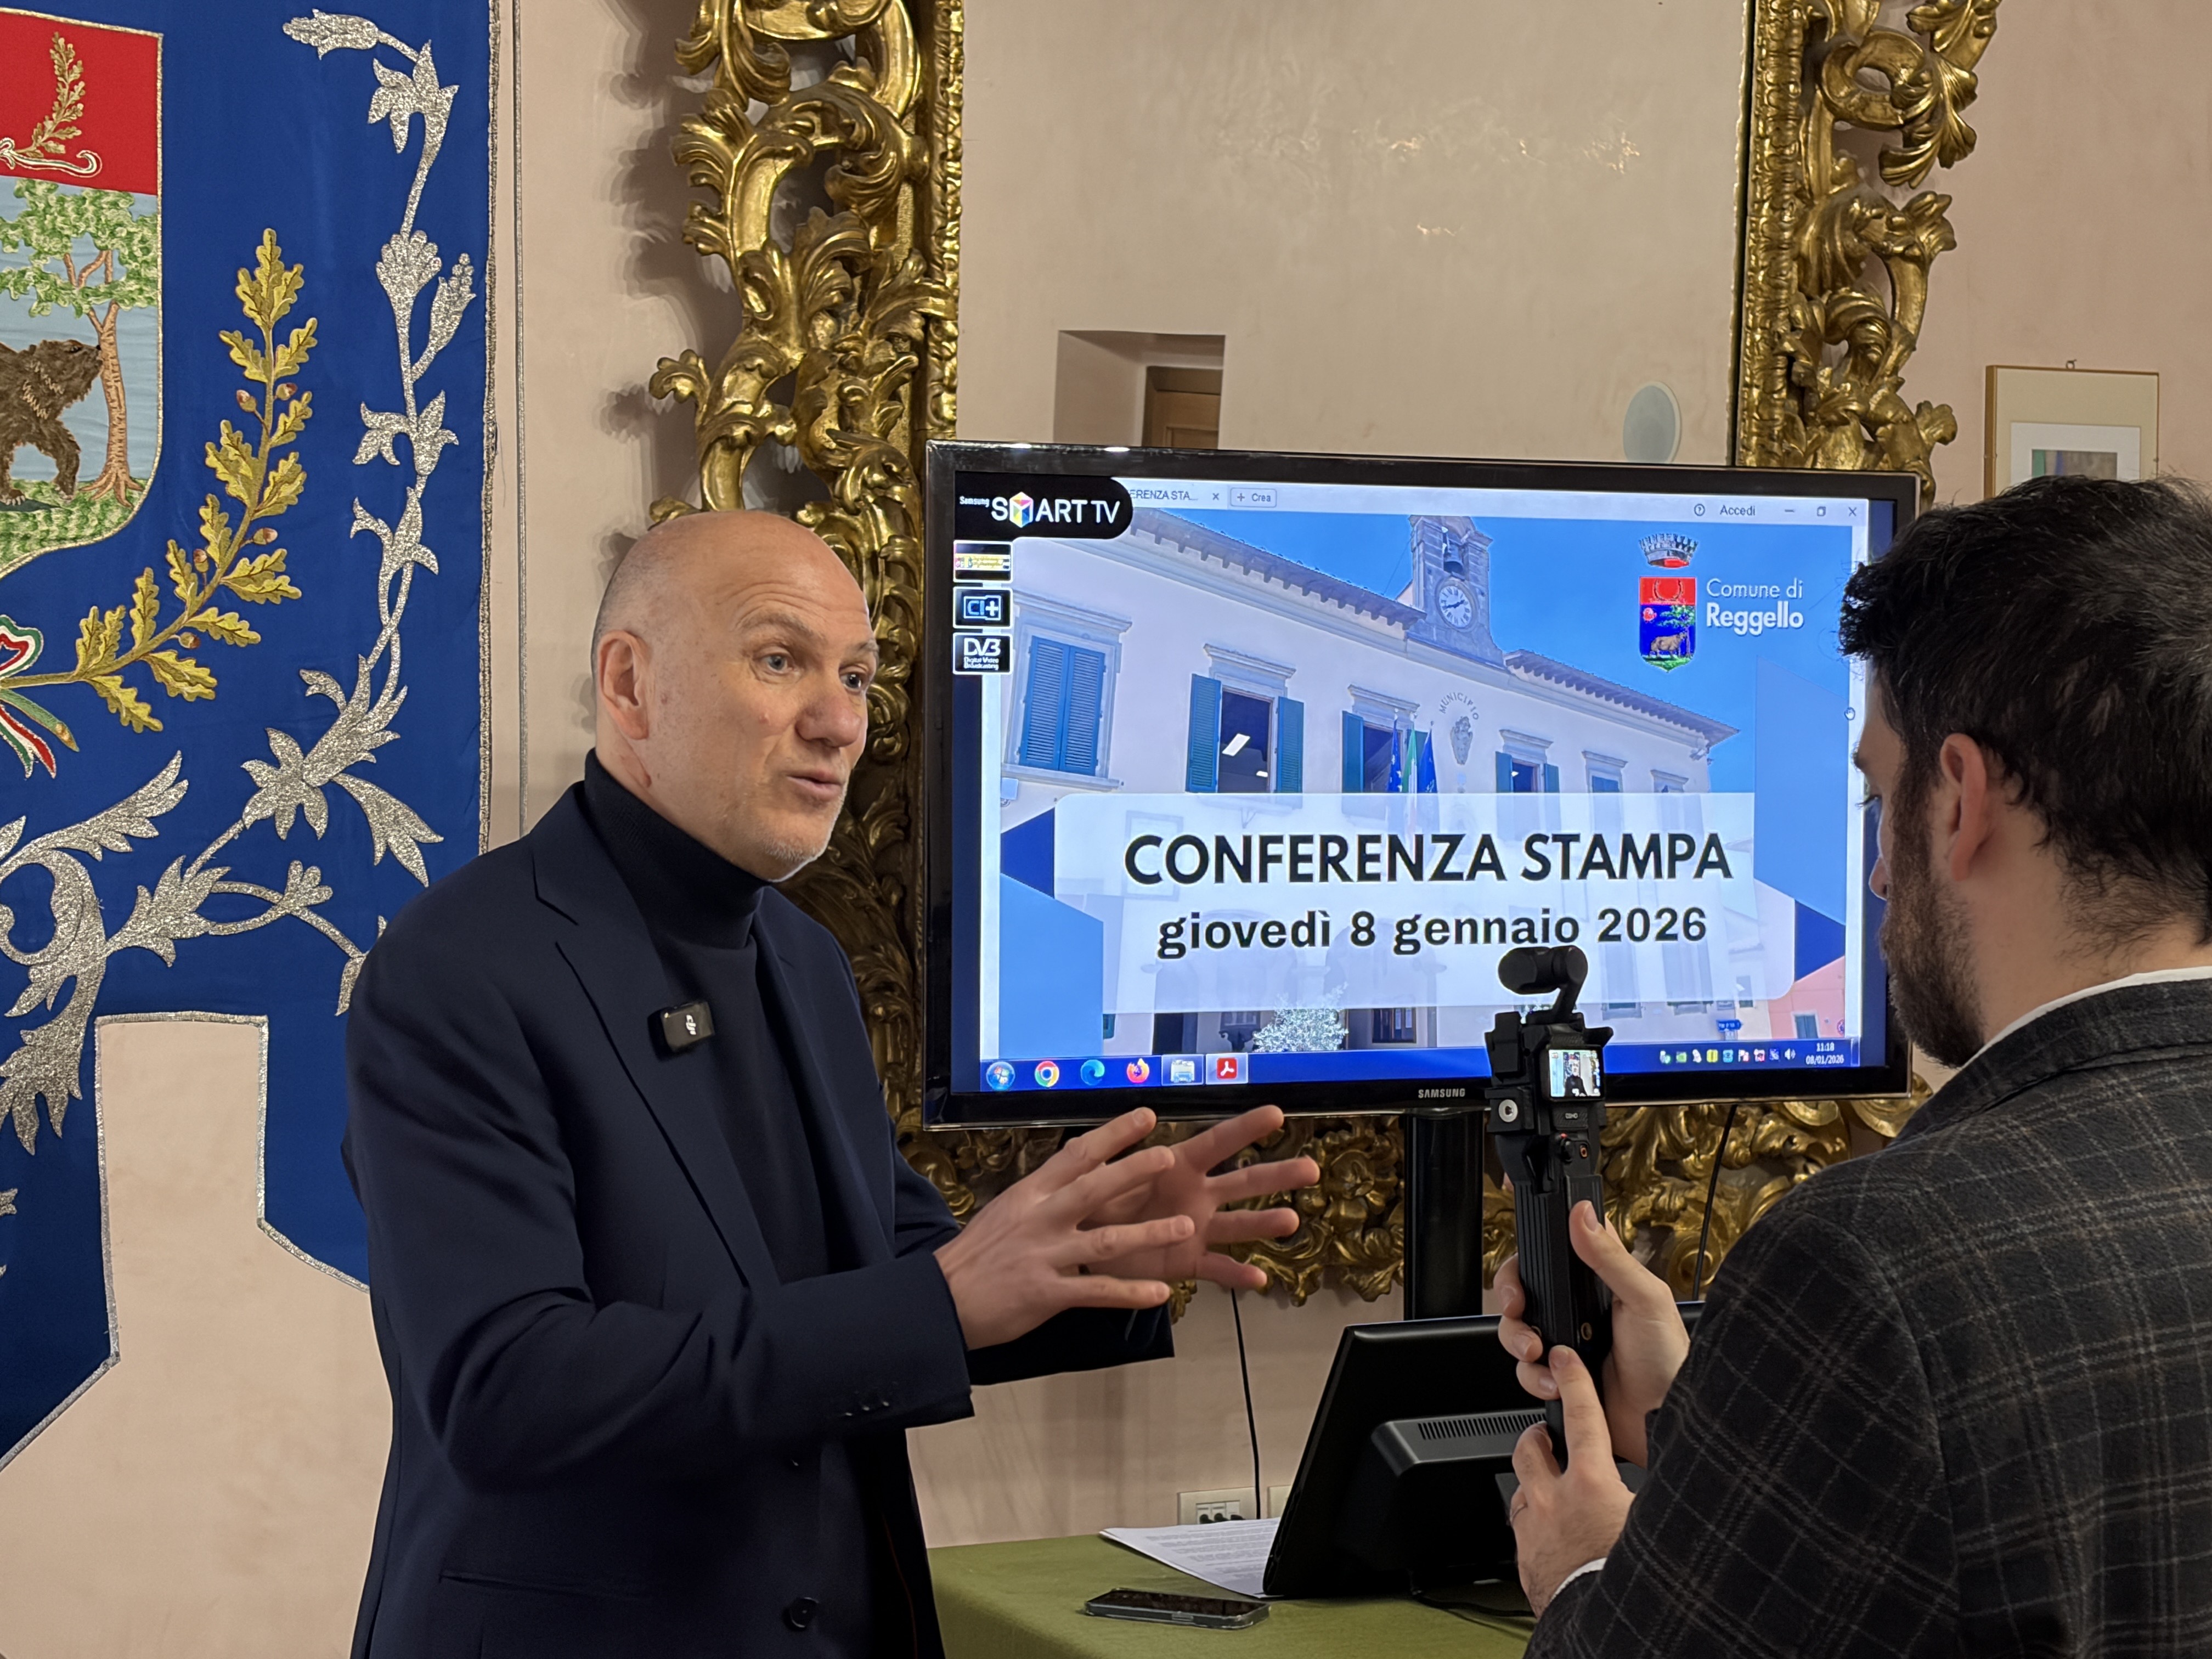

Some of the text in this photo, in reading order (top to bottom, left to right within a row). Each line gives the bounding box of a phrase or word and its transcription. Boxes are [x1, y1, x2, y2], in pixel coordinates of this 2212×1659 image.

[960, 496, 990, 507] Samsung
[1251, 493, 1271, 502] Crea
[1091, 501, 1120, 523] TV
[1719, 504, 1756, 516] Accedi
[1706, 577, 1803, 599] Comune di
[1706, 601, 1804, 635] Reggello
[964, 638, 1001, 656] DVB
[1439, 692, 1479, 720] MUNICIPIO
[1125, 833, 1733, 884] CONFERENZA STAMPA
[1157, 907, 1706, 959] giovedì 8 gennaio 2026
[1816, 1042, 1835, 1052] 11:18
[1805, 1054, 1844, 1065] 08/01/2026
[1418, 1088, 1466, 1099] SAMSUNG
